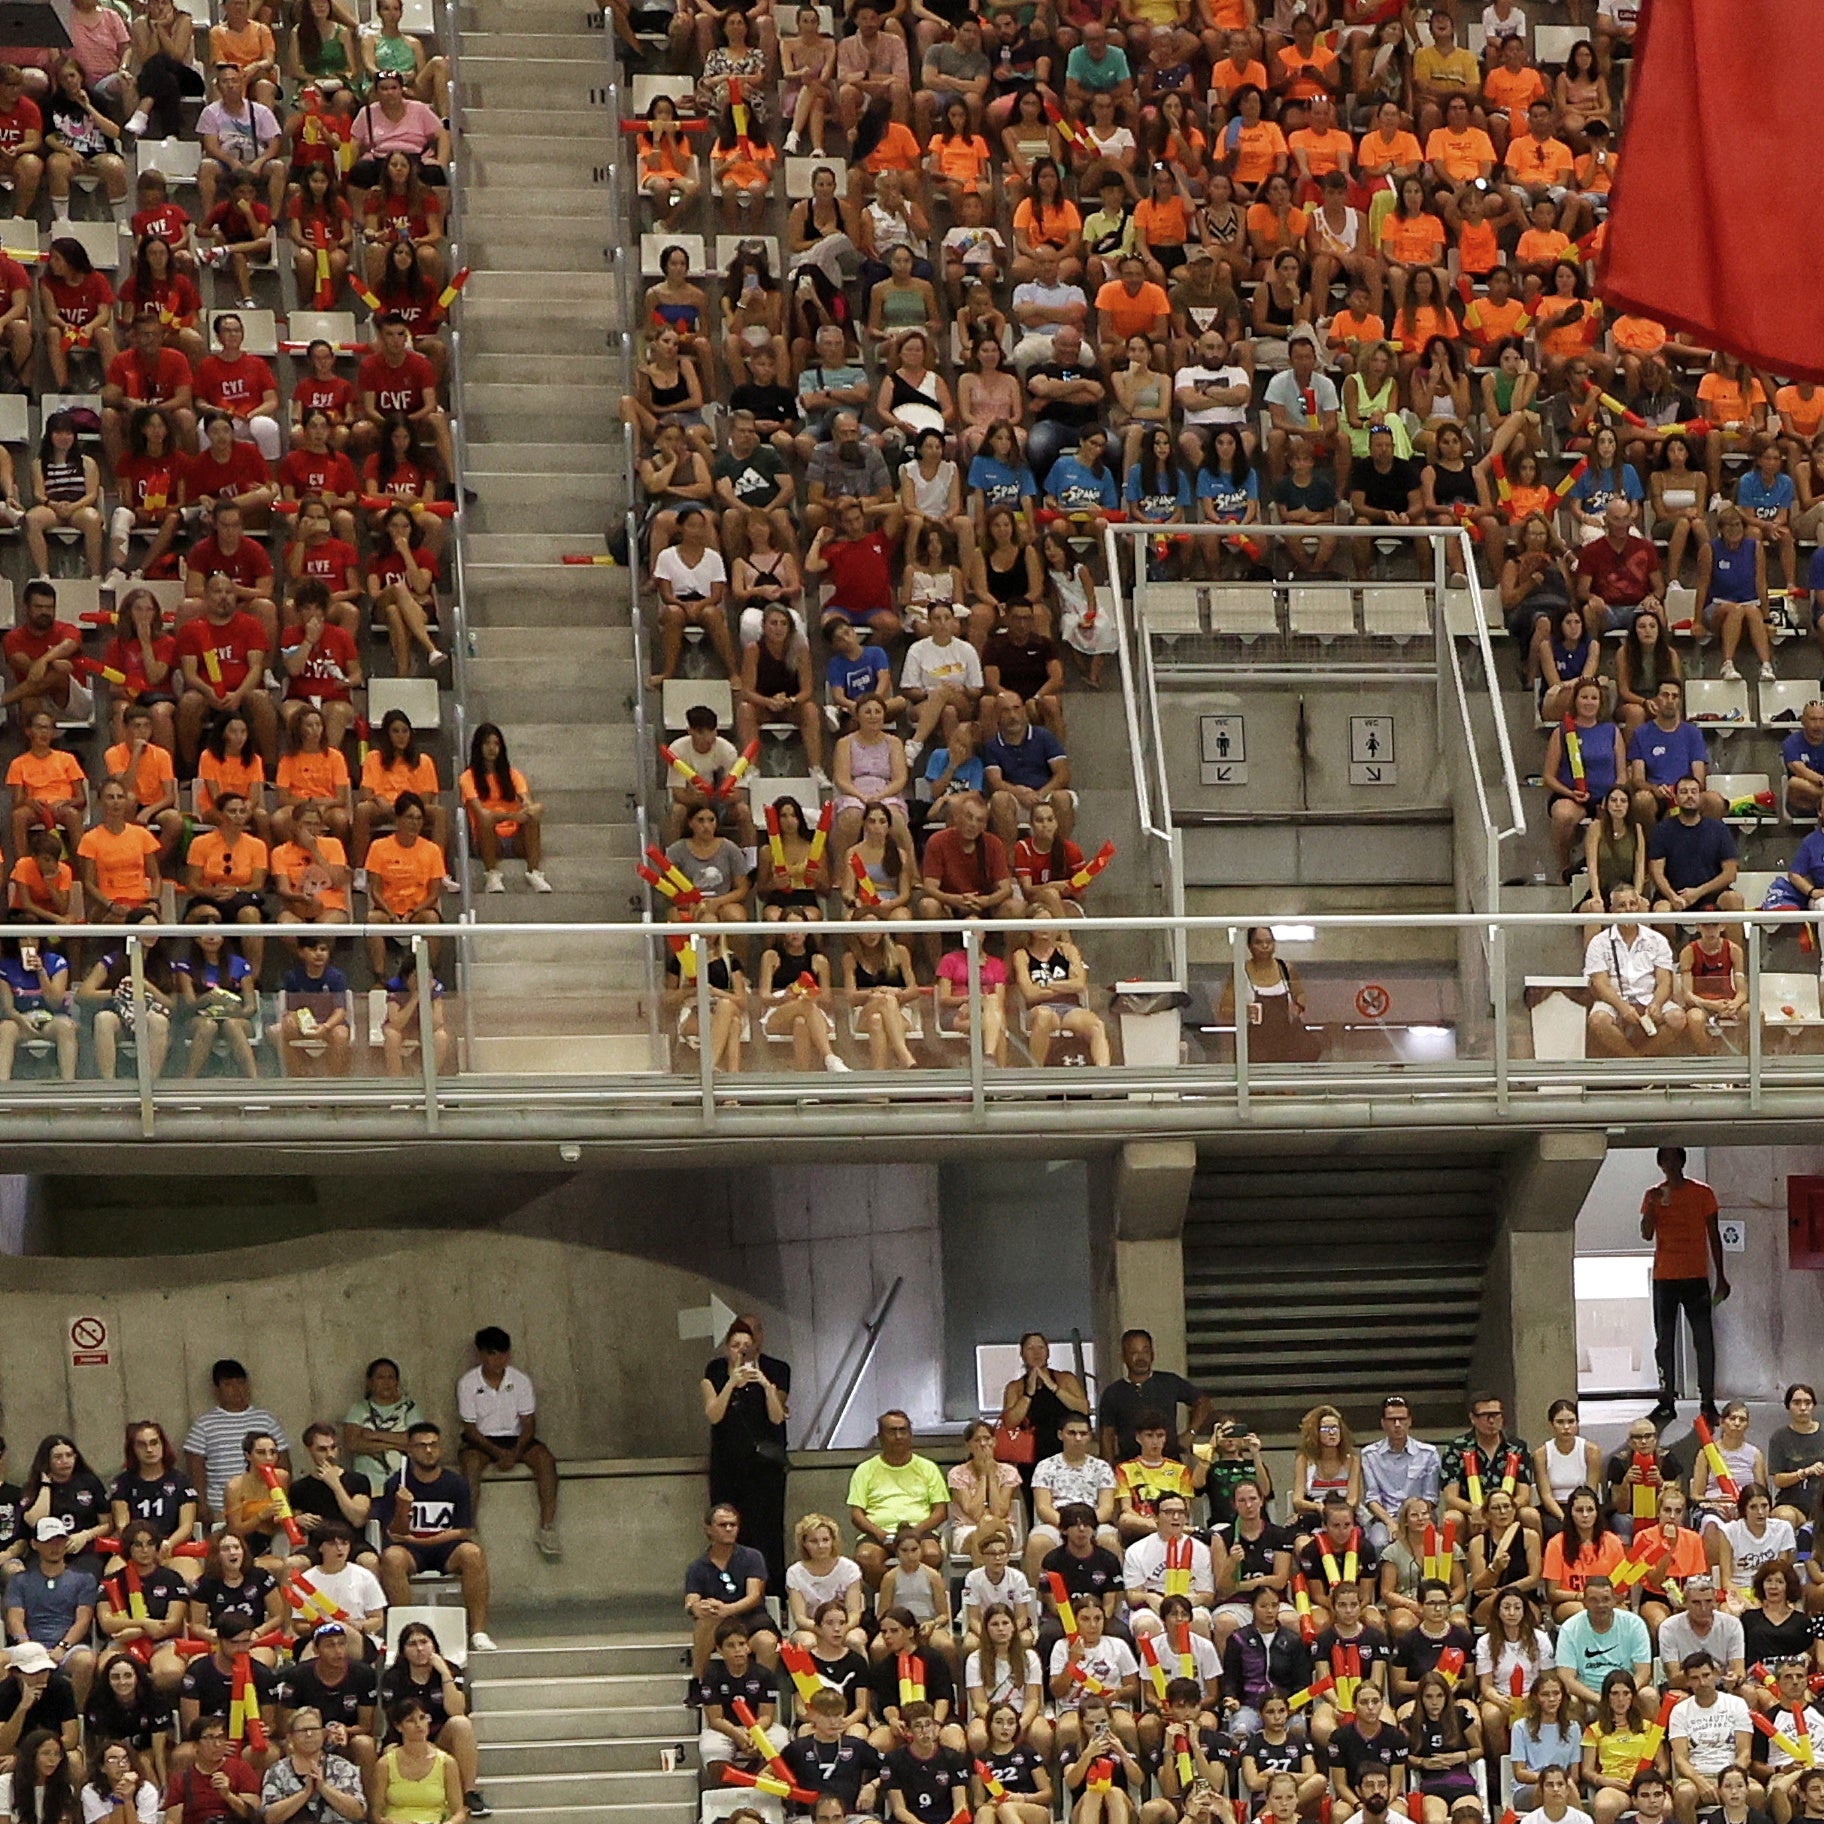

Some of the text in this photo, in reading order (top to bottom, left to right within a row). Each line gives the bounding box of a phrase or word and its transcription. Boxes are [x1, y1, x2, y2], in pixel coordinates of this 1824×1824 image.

[222, 380, 246, 397] CVF
[312, 392, 334, 407] CVF
[380, 389, 412, 410] CVF
[307, 560, 331, 574] CVF
[137, 1499, 164, 1518] 11
[410, 1504, 455, 1531] ILA
[1430, 1735, 1443, 1749] 5
[818, 1763, 837, 1780] 7
[991, 1766, 1019, 1783] 22
[1265, 1758, 1292, 1775] 27
[918, 1792, 932, 1808] 9
